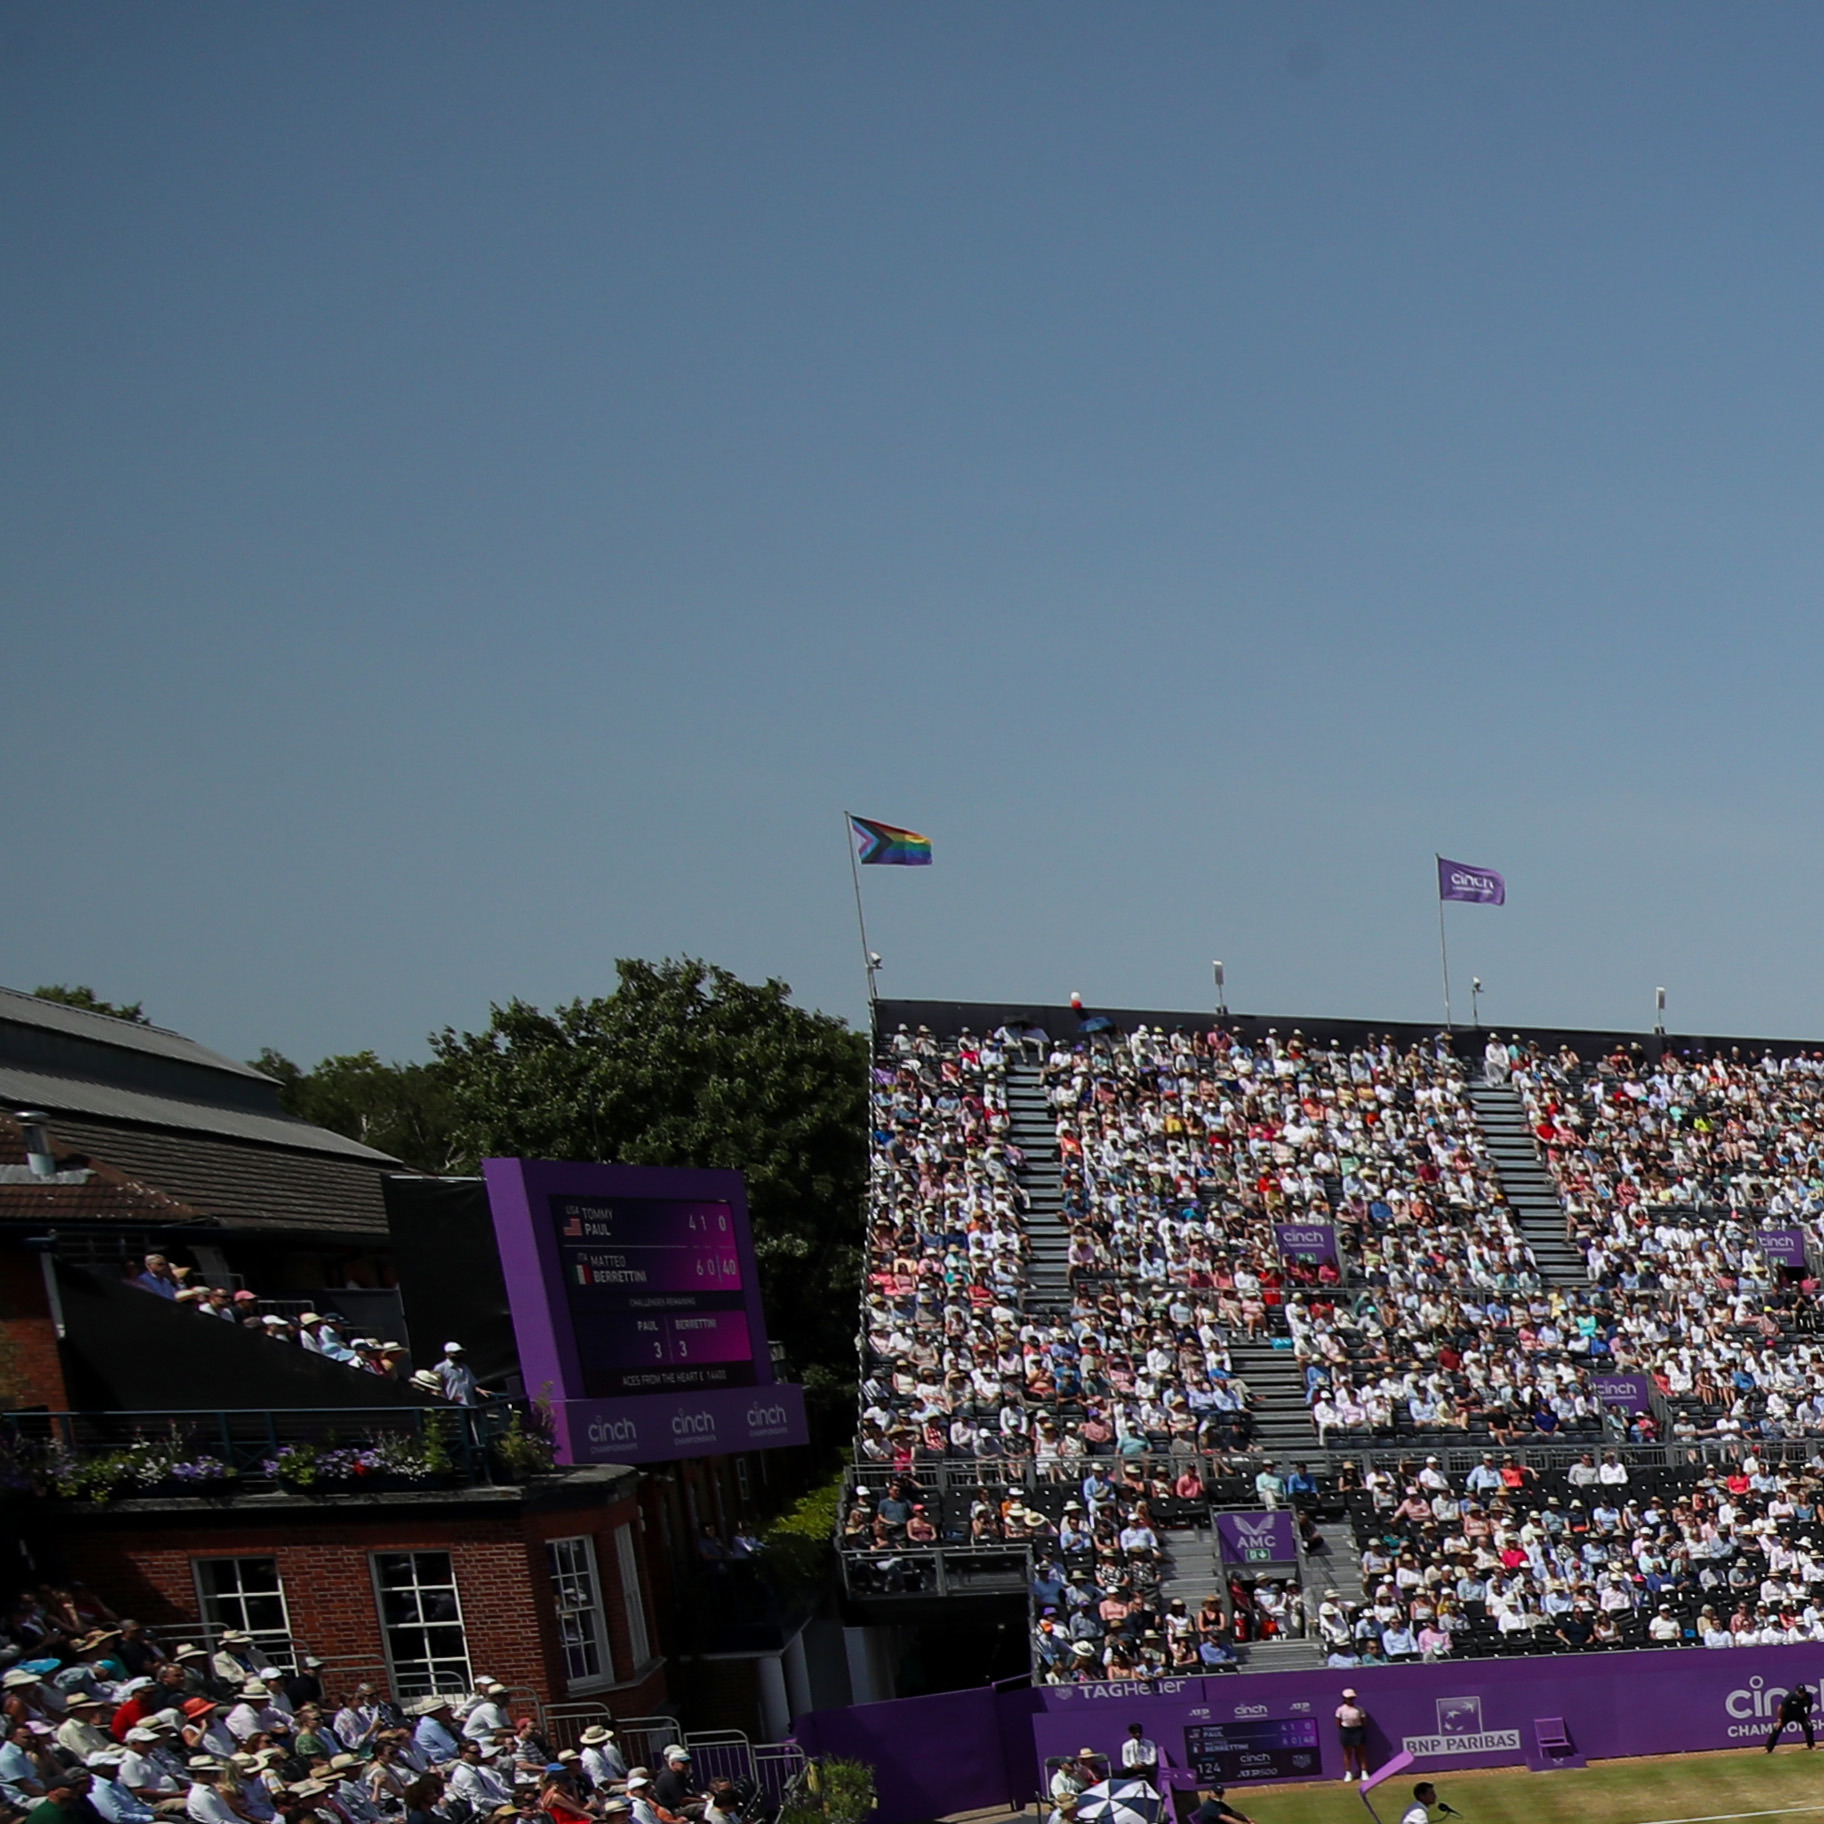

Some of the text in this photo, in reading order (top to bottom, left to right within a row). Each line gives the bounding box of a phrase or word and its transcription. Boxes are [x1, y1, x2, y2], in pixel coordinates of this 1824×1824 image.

[582, 1207, 613, 1219] TOMMY
[689, 1214, 696, 1230] 4
[719, 1215, 727, 1232] 0
[584, 1223, 612, 1236] PAUL
[1283, 1229, 1324, 1243] cinch
[1759, 1234, 1794, 1247] cinch
[590, 1255, 737, 1276] MATTEO 6 0 40
[593, 1270, 648, 1283] BERRETTINI
[638, 1318, 717, 1331] PAUL BERRETTINI
[654, 1340, 688, 1359] 3 3
[623, 1375, 641, 1386] ACES
[642, 1374, 662, 1385] FROM
[662, 1372, 676, 1383] THE
[677, 1371, 698, 1382] HEART
[672, 1408, 715, 1434] cinch
[747, 1402, 787, 1427] cinch
[588, 1415, 637, 1442] cinch
[1237, 1535, 1276, 1548] AMC
[1234, 1703, 1268, 1715] cinch
[1406, 1733, 1517, 1753] BNP PARIBAS
[1240, 1753, 1271, 1763] cinch
[1198, 1763, 1221, 1774] 124
